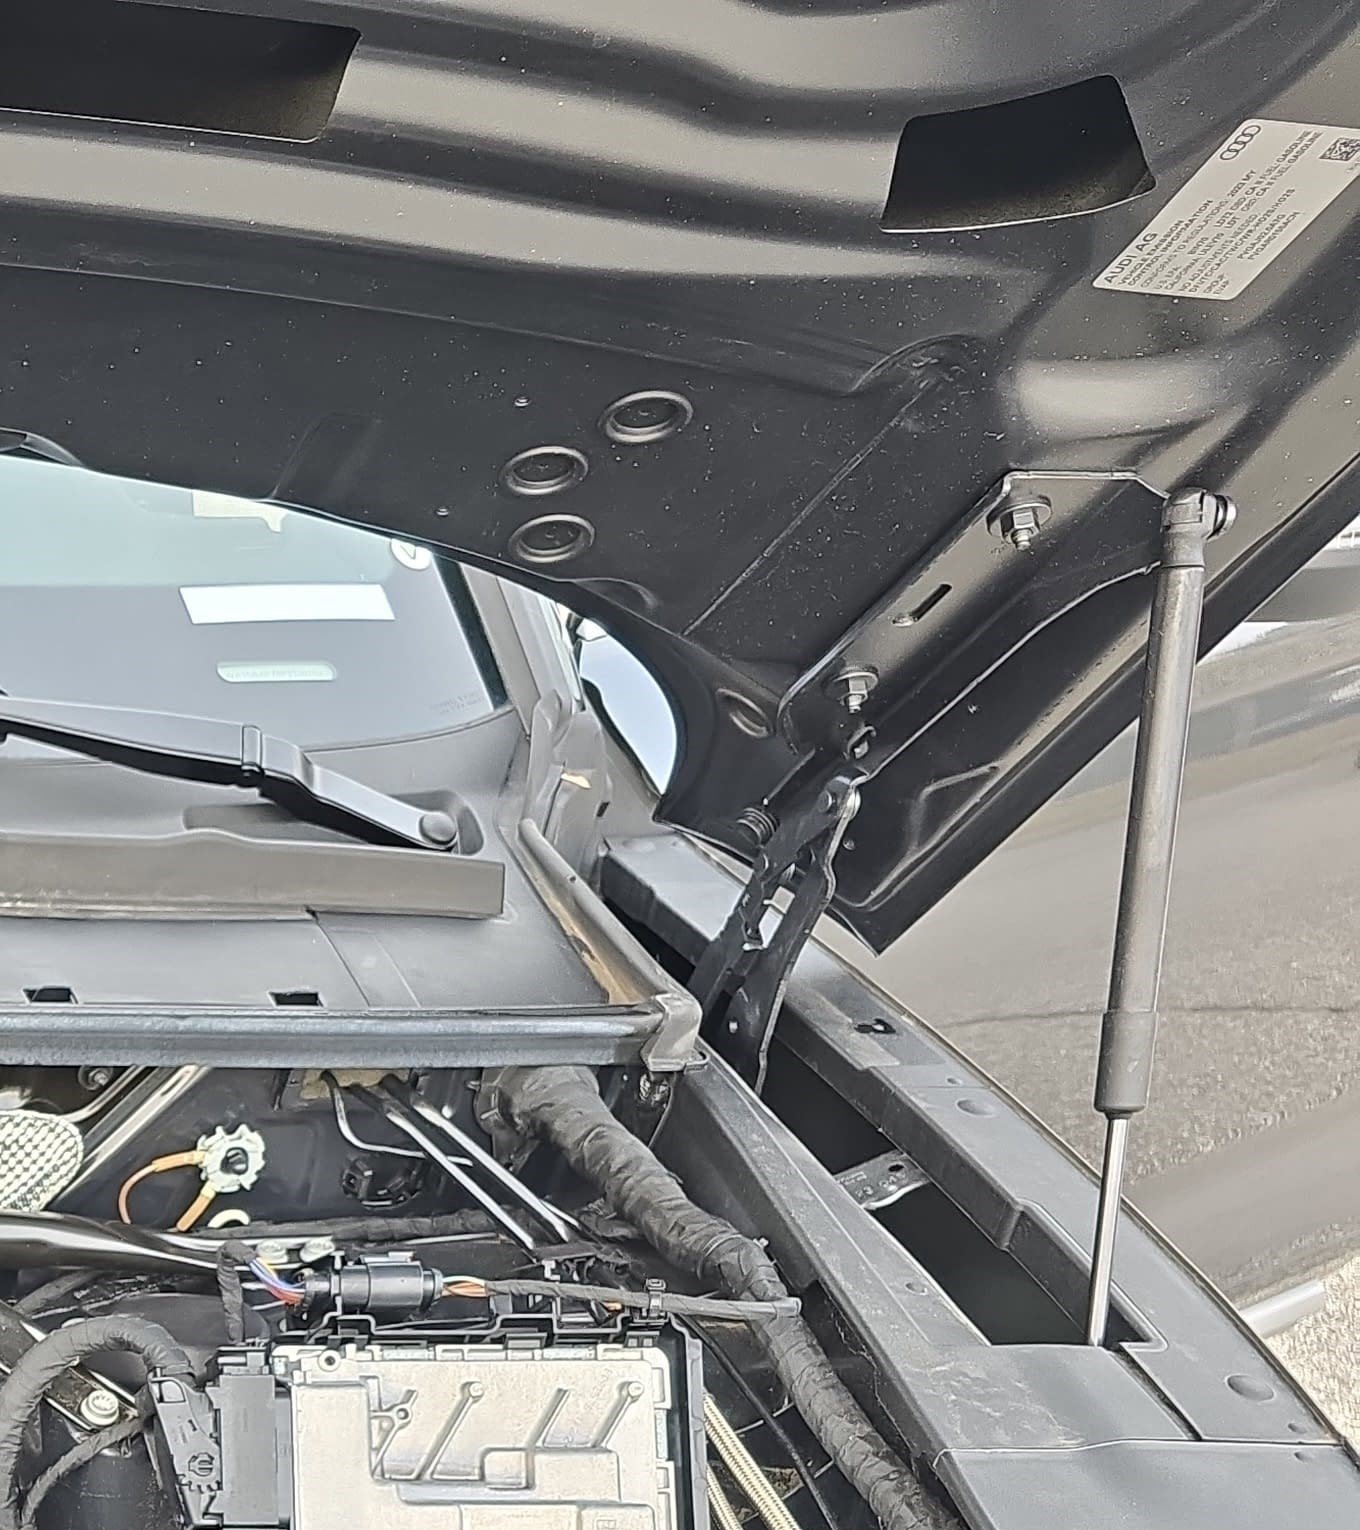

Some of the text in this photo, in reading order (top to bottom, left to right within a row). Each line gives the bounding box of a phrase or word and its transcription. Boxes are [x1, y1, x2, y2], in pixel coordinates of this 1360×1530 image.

[1277, 130, 1311, 162] GASOLINE
[1287, 132, 1322, 163] GASOLINE
[1103, 233, 1157, 282] AUDI AG
[1120, 220, 1183, 284] VEHICLE EMISSION
[1128, 200, 1213, 285] CONTROL INFORMATION
